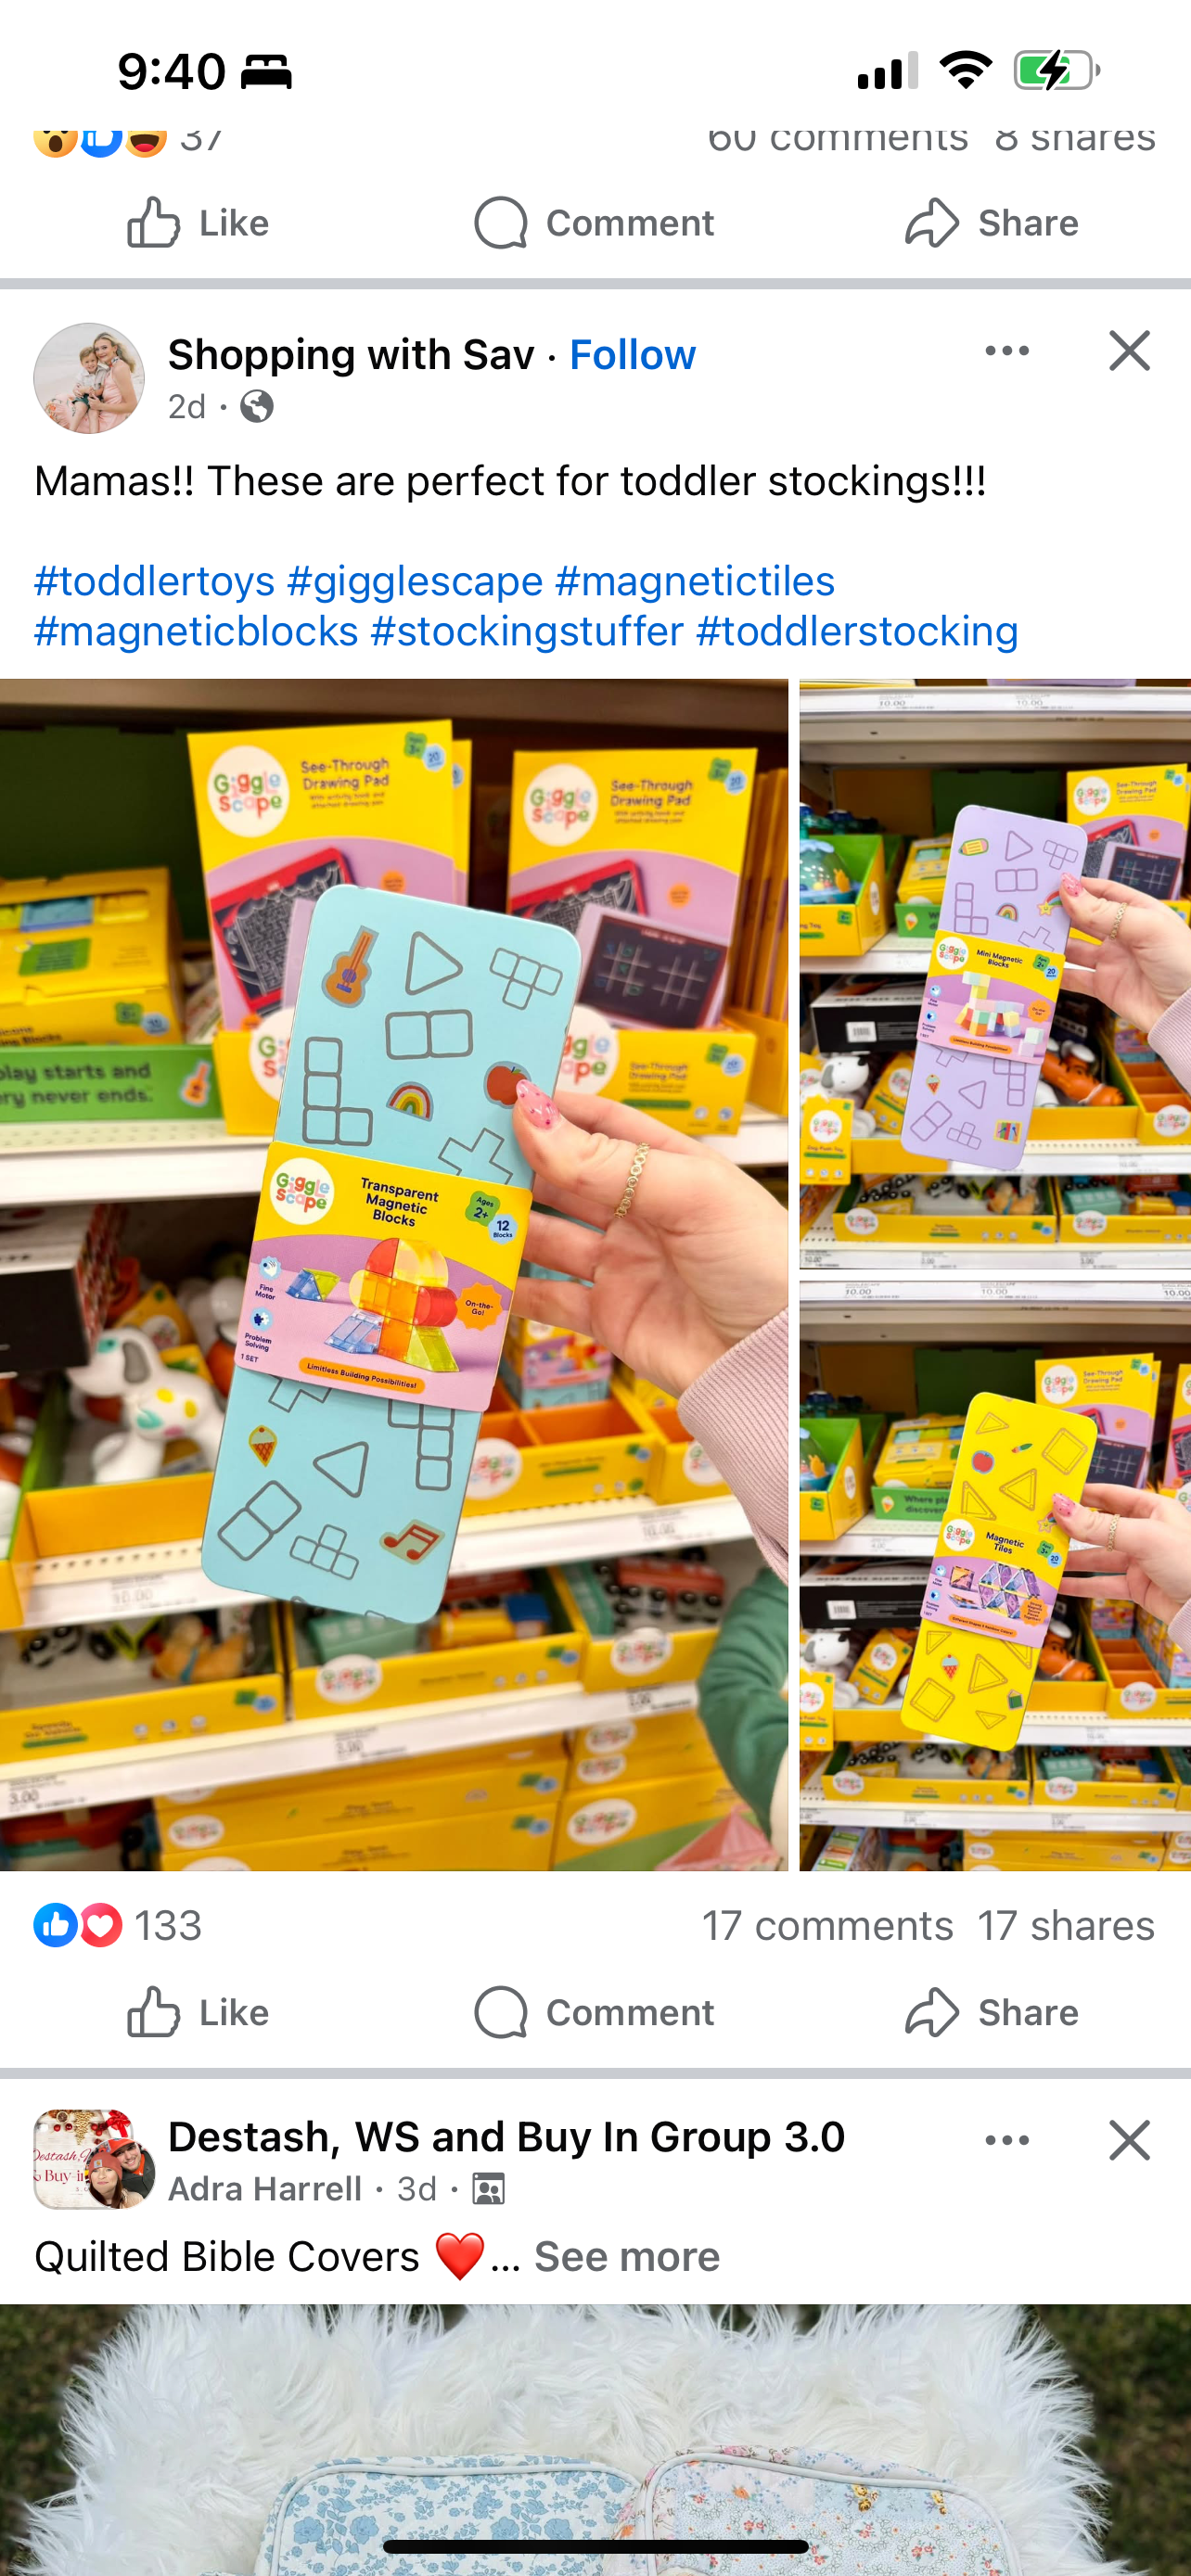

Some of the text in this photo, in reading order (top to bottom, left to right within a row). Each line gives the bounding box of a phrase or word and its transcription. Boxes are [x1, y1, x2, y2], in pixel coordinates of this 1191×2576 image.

[118, 53, 226, 91] 9:40
[180, 131, 222, 151] 37
[709, 131, 967, 151] 60 comments
[995, 131, 1155, 151] 8 shares
[200, 207, 269, 236] Like
[546, 209, 715, 237] Comment
[979, 208, 1079, 237] Share
[168, 337, 535, 378] Shopping with Sav
[571, 338, 697, 371] Follow
[169, 392, 205, 419] 2d
[36, 463, 985, 504] Mamas!! These are perfect for toddler stockings!!!
[33, 563, 834, 605] #toddlertoys #gigglescape #magnetictiles
[33, 613, 1018, 655] #magneticblocks #stockingstuffer #toddlerstocking
[301, 758, 390, 775] See-Through
[214, 771, 281, 798] Giggle
[302, 774, 390, 792] Drawing Pad
[611, 779, 693, 793] See-Through
[610, 795, 691, 809] Drawing Pad
[977, 949, 1023, 964] Mini Magnetic
[988, 959, 1009, 968] Blocks
[44, 1064, 106, 1080] starts
[112, 1063, 151, 1080] and
[31, 1091, 90, 1105] never
[276, 1172, 330, 1198] Giggle
[361, 1177, 440, 1203] Transparent
[365, 1193, 428, 1215] Magnetic
[473, 1207, 489, 1218] 2+
[476, 1196, 494, 1207] Ages
[373, 1209, 416, 1227] Blocks
[496, 1220, 510, 1231] 12
[255, 1290, 275, 1300] Motor
[259, 1283, 274, 1293] Fine
[465, 1299, 493, 1309] On-the-
[244, 1333, 272, 1344] Problem
[245, 1340, 269, 1352] Solving
[245, 1354, 259, 1363] SET
[307, 1362, 417, 1389] Limitless Building Possibilities!
[904, 1495, 948, 1505] Where pla
[905, 1505, 946, 1514] discover
[986, 1532, 1024, 1548] Magnetic
[994, 1543, 1013, 1554] Tiles
[135, 1909, 201, 1942] 133
[703, 1909, 954, 1941] 17 comments
[979, 1908, 1155, 1941] 17 shares
[200, 1996, 269, 2026] Like
[546, 1998, 715, 2027] Comment
[979, 1997, 1079, 2027] Share
[170, 2120, 845, 2161] Destash, WS and Buy In Group 3.0
[167, 2174, 361, 2201] Adra Harrell
[398, 2174, 436, 2201] 3d
[35, 2238, 419, 2276] Quilted Bible Covers
[535, 2239, 720, 2273] See more
